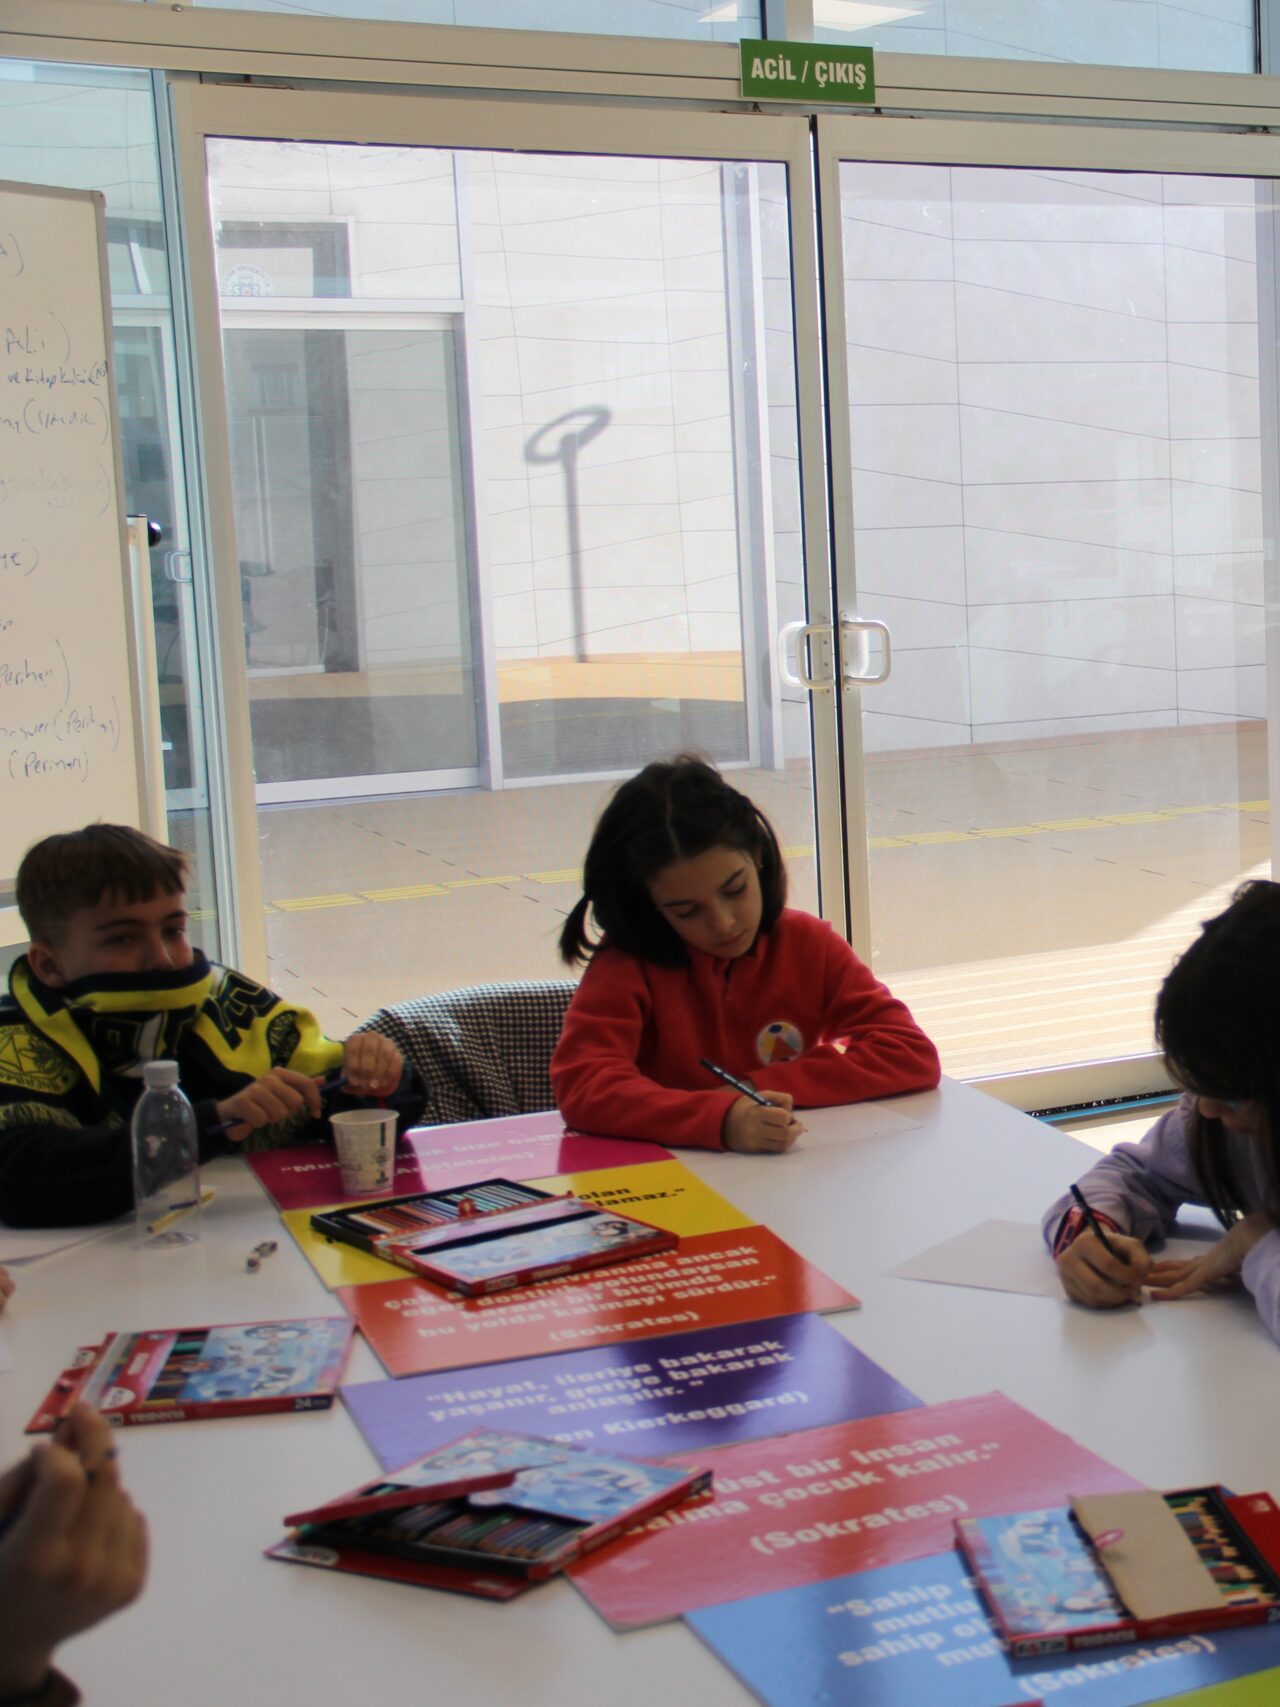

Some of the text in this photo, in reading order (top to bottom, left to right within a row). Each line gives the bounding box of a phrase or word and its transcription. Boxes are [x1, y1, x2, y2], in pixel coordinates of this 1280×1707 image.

[751, 54, 797, 81] ACİL
[814, 61, 867, 90] ÇIKIŞ
[578, 1187, 632, 1201] olan
[676, 1245, 759, 1266] ancak
[402, 1301, 467, 1318] eğer
[476, 1285, 584, 1307] dostluk
[590, 1256, 760, 1291] yolundaysan
[566, 1289, 605, 1306] bir
[612, 1273, 724, 1299] biçimde
[416, 1325, 457, 1338] bu
[465, 1311, 547, 1333] yolda
[552, 1294, 667, 1319] kalmayı
[547, 1310, 701, 1343] (Sokrates)
[554, 1362, 654, 1387] ileriye
[658, 1340, 785, 1369] bakarak
[565, 1374, 662, 1401] geriye
[668, 1351, 796, 1381] bakarak
[602, 1390, 810, 1436] Kierkeggard)
[784, 1456, 843, 1479] bir
[849, 1433, 964, 1466] insan
[758, 1470, 887, 1509] çocuk
[750, 1493, 970, 1557] (Sokrates)
[837, 1631, 946, 1668] sahip
[1017, 1634, 1218, 1699] (Sokrates)
